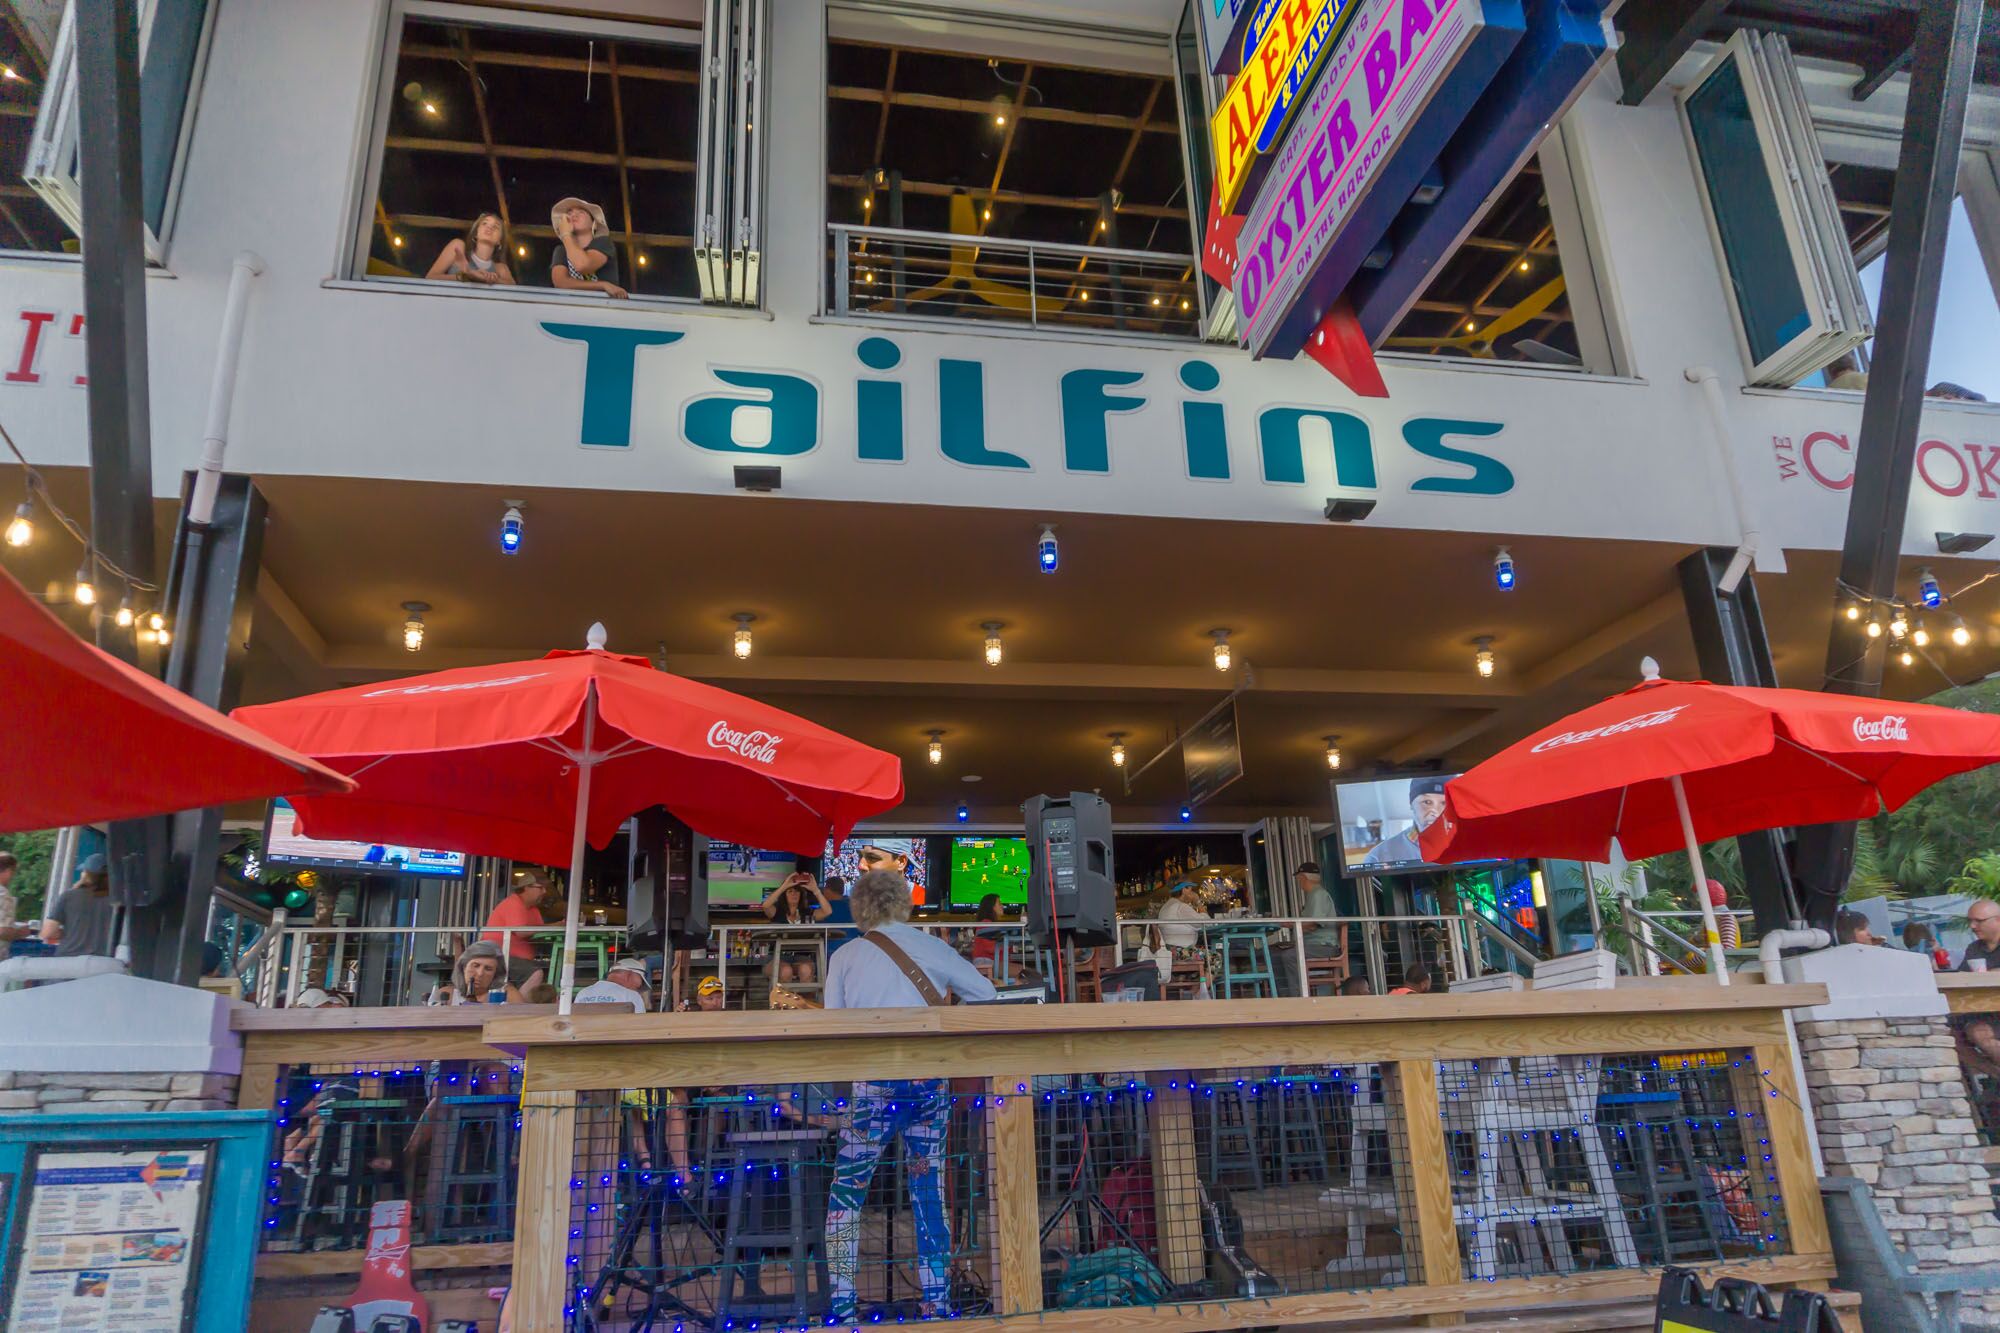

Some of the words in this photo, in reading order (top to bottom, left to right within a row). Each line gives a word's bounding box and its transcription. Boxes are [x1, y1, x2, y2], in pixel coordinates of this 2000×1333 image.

[1241, 97, 1359, 319] OYSTER
[1362, 0, 1448, 118] BA
[1296, 244, 1314, 276] ON
[1313, 207, 1335, 246] THE
[1338, 124, 1393, 212] HARBOR
[1772, 435, 1800, 481] WE
[1802, 431, 2000, 499] COK
[706, 719, 784, 765] Coca-Cola
